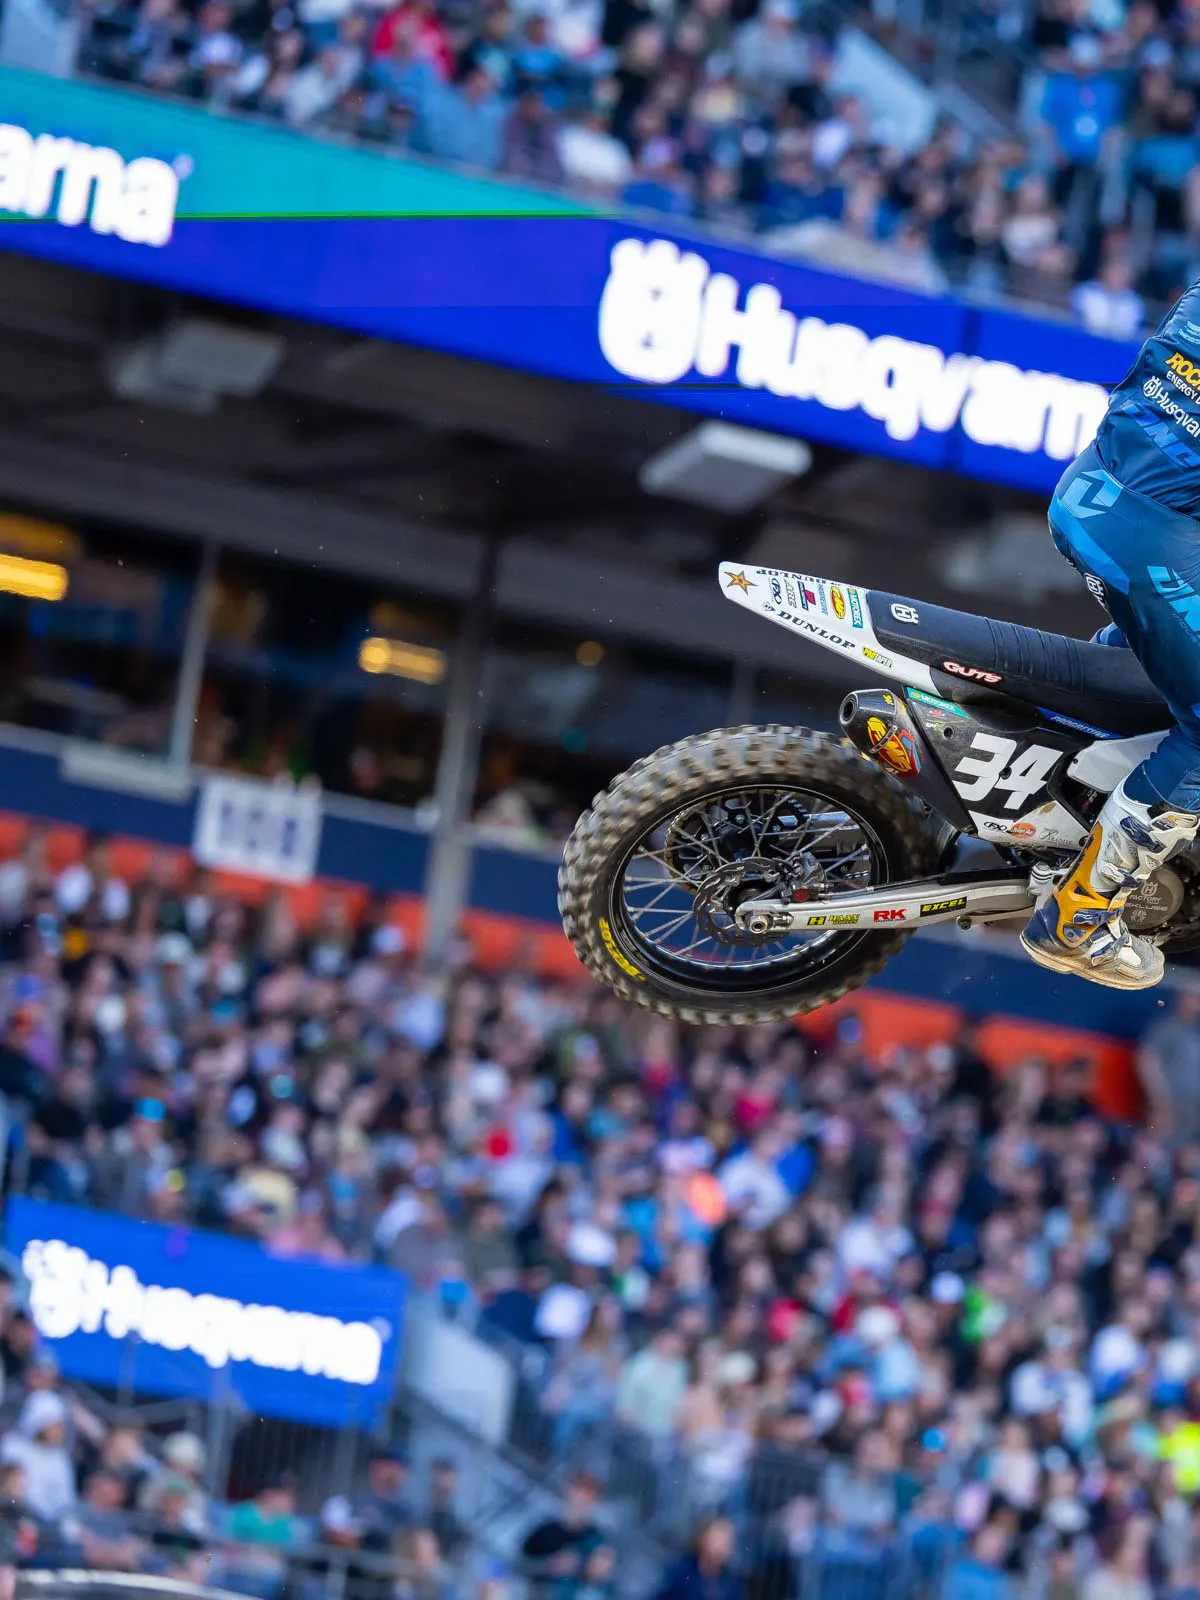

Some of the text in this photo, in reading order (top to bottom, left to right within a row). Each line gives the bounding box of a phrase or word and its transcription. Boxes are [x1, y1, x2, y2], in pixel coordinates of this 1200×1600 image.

[696, 272, 1110, 460] Husqvarn
[1166, 371, 1196, 403] ENERGY
[831, 586, 846, 619] FMF
[851, 592, 862, 627] MOTOREX
[777, 609, 856, 651] DUNLOP
[943, 663, 1003, 684] GUTS
[952, 732, 1064, 810] 34
[873, 908, 906, 921] RK
[921, 898, 967, 912] EXCEL
[1129, 894, 1163, 903] FACTORY
